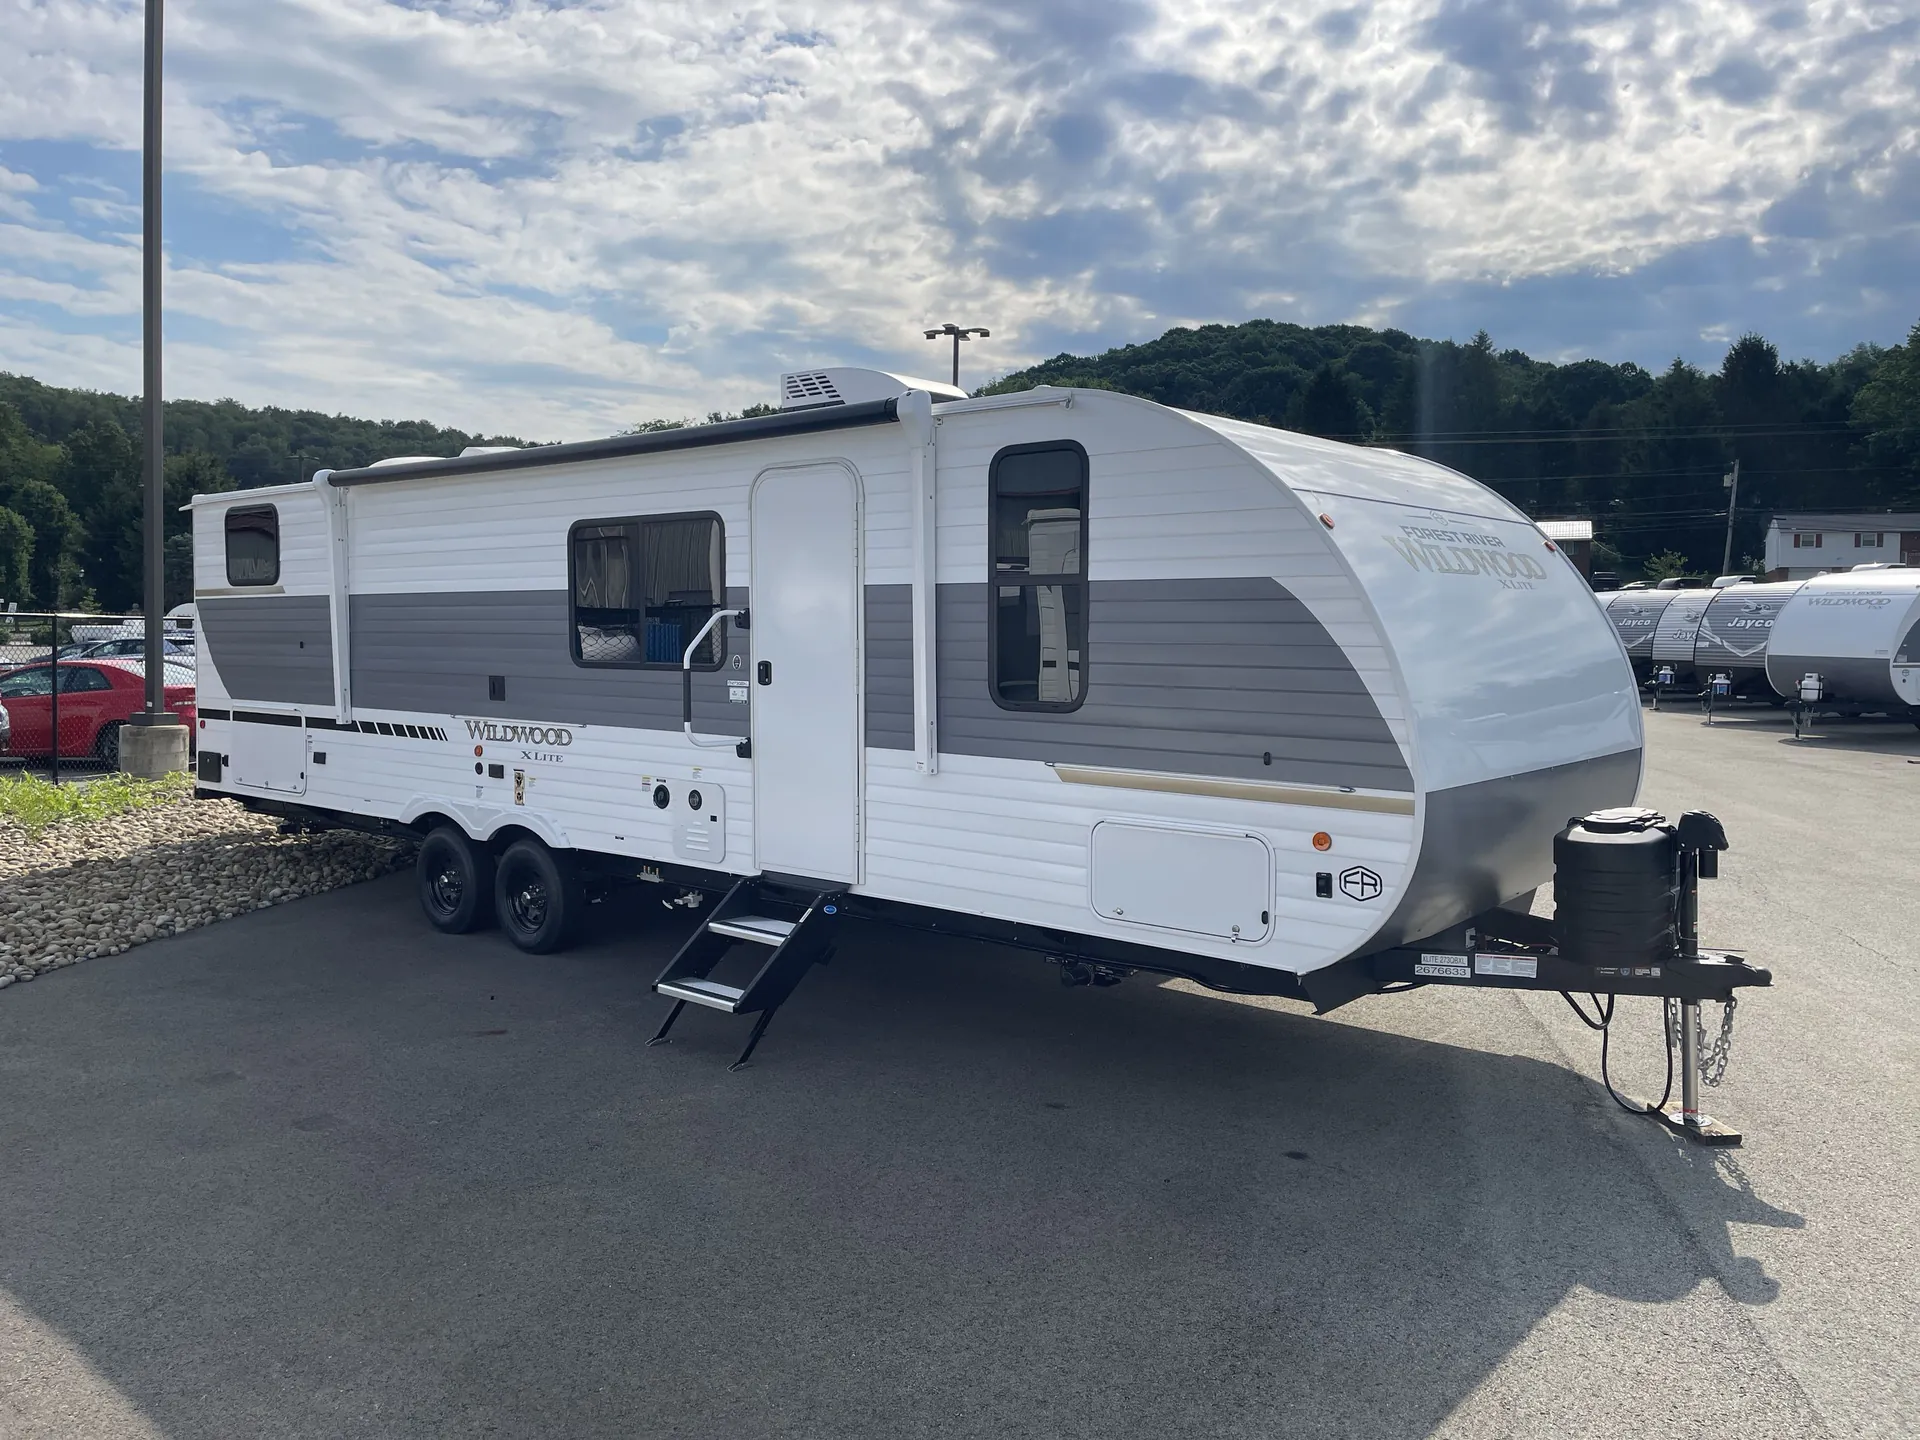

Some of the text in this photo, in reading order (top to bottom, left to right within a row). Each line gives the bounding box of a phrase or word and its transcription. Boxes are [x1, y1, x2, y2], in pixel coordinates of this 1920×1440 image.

[1399, 525, 1507, 548] FOREST RIVER
[1381, 535, 1548, 580] WILDWOOD
[1808, 597, 1892, 606] WILDWOOD
[1618, 618, 1651, 628] Jayco
[1727, 616, 1776, 630] Jayco
[464, 719, 573, 747] WILDWOOD
[1416, 965, 1467, 976] 2676633
